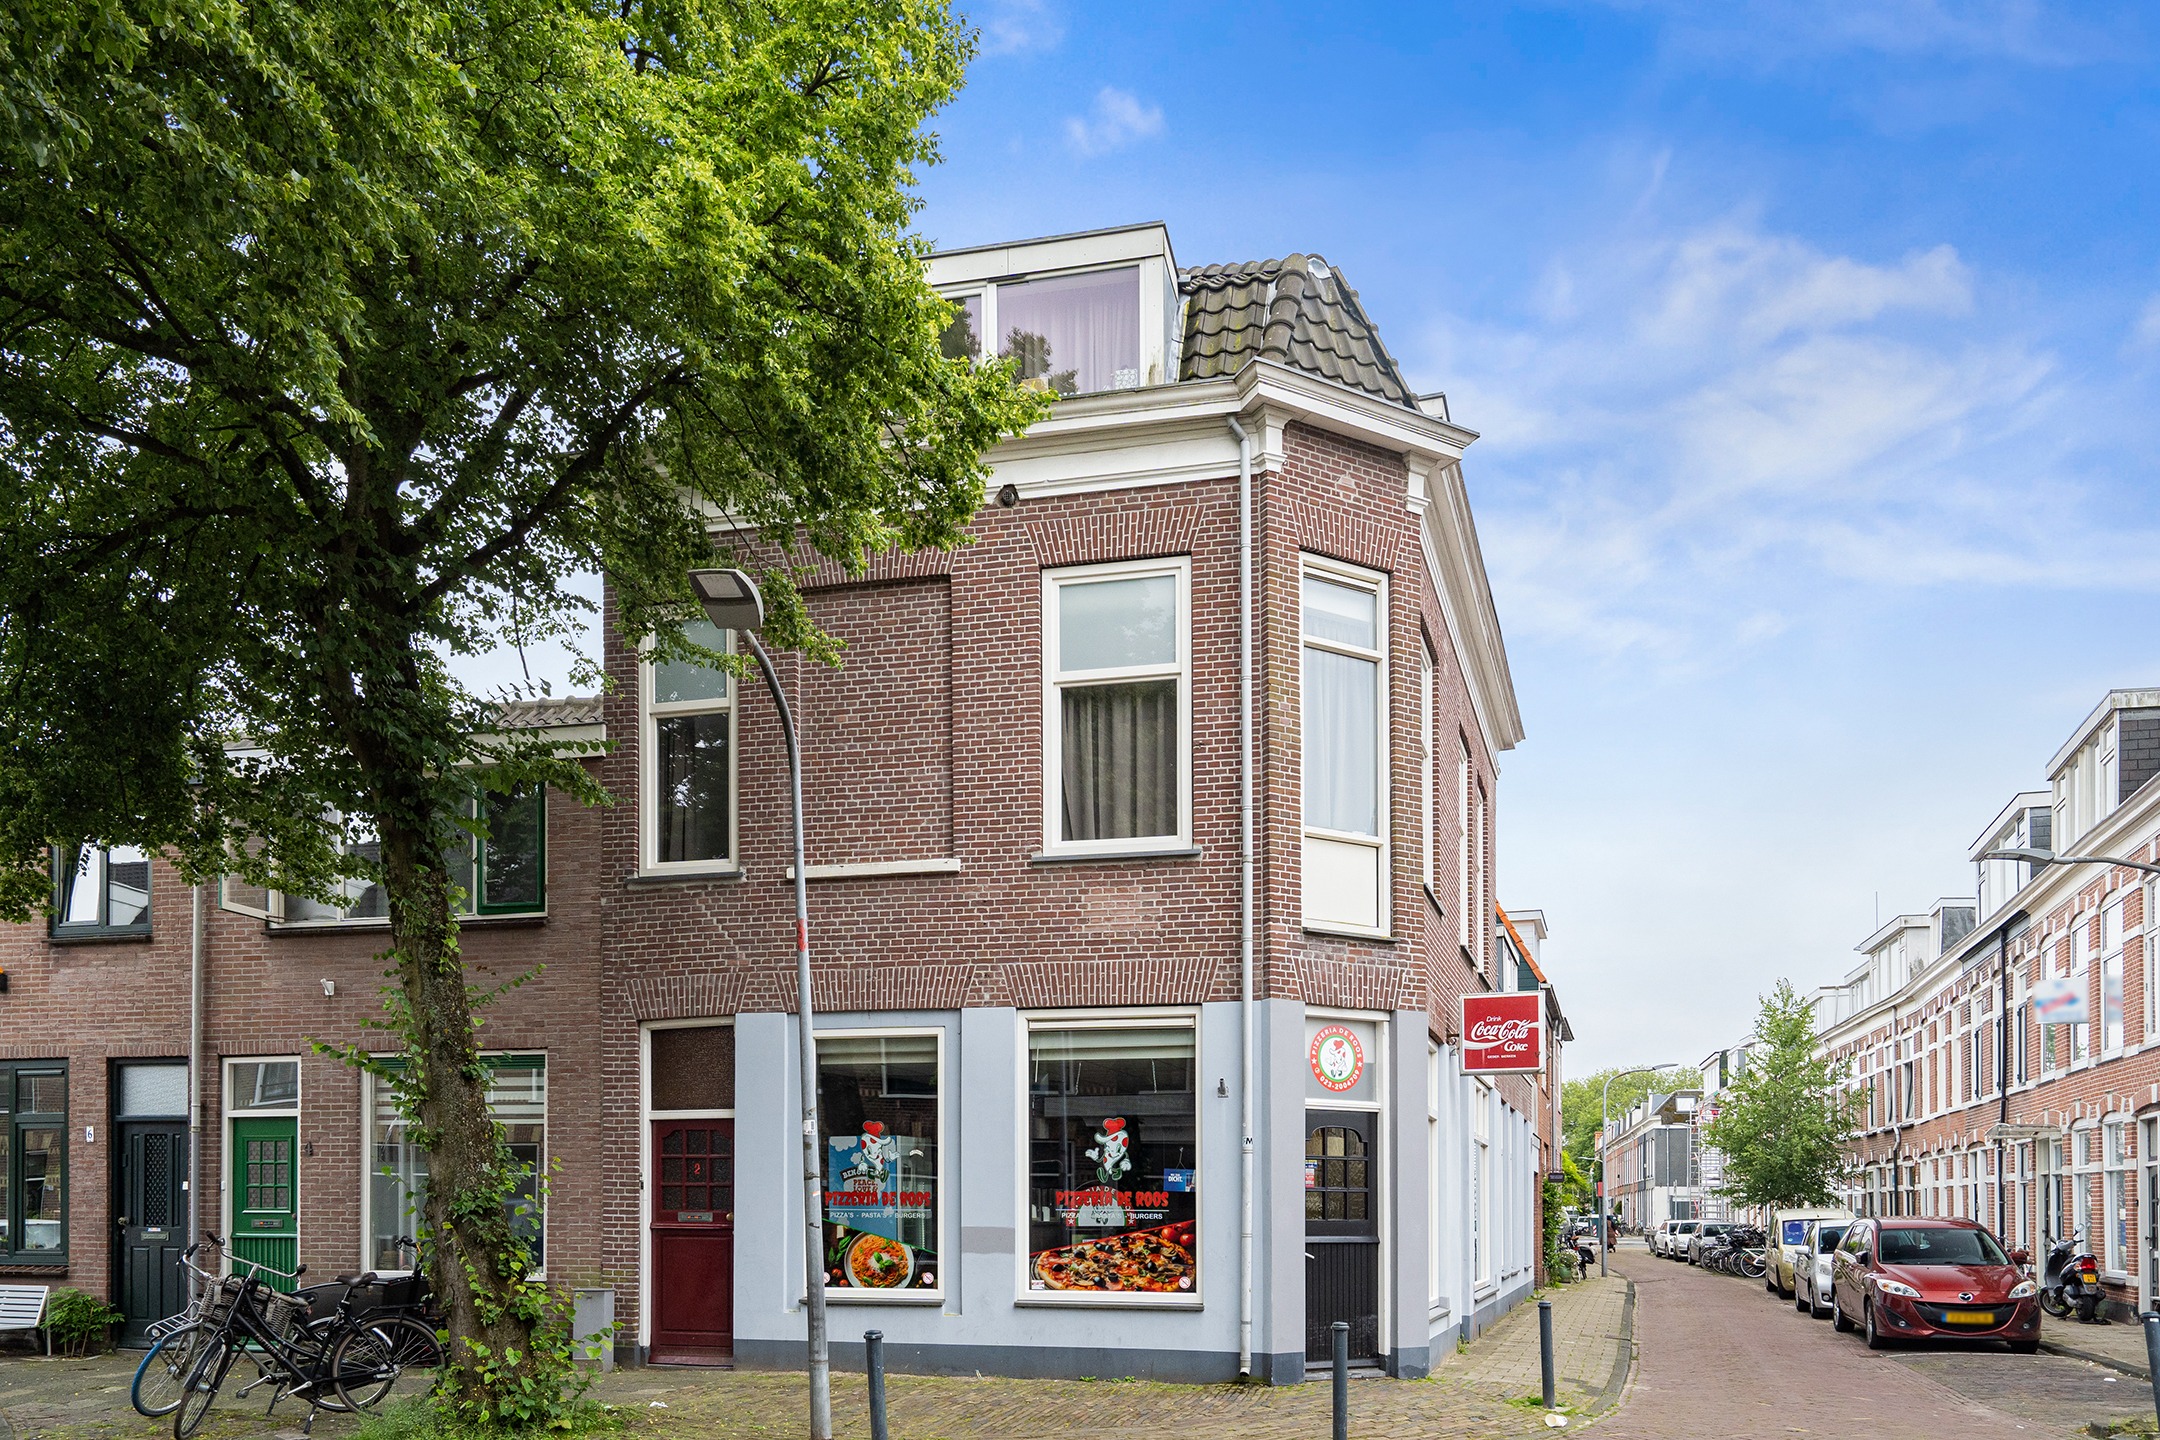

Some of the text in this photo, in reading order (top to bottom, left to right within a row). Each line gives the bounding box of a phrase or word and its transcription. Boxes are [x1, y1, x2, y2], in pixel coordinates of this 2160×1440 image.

[1311, 1027, 1362, 1058] PIZZERIA DE ROOS
[1504, 1041, 1528, 1052] Coke
[1319, 1069, 1360, 1090] 023-2004709
[693, 1162, 701, 1175] 2
[825, 1191, 931, 1207] PIZZERIA DE ROOS
[1056, 1191, 1170, 1208] PIZZERIA DE ROOS
[1131, 1212, 1163, 1220] BURGERS
